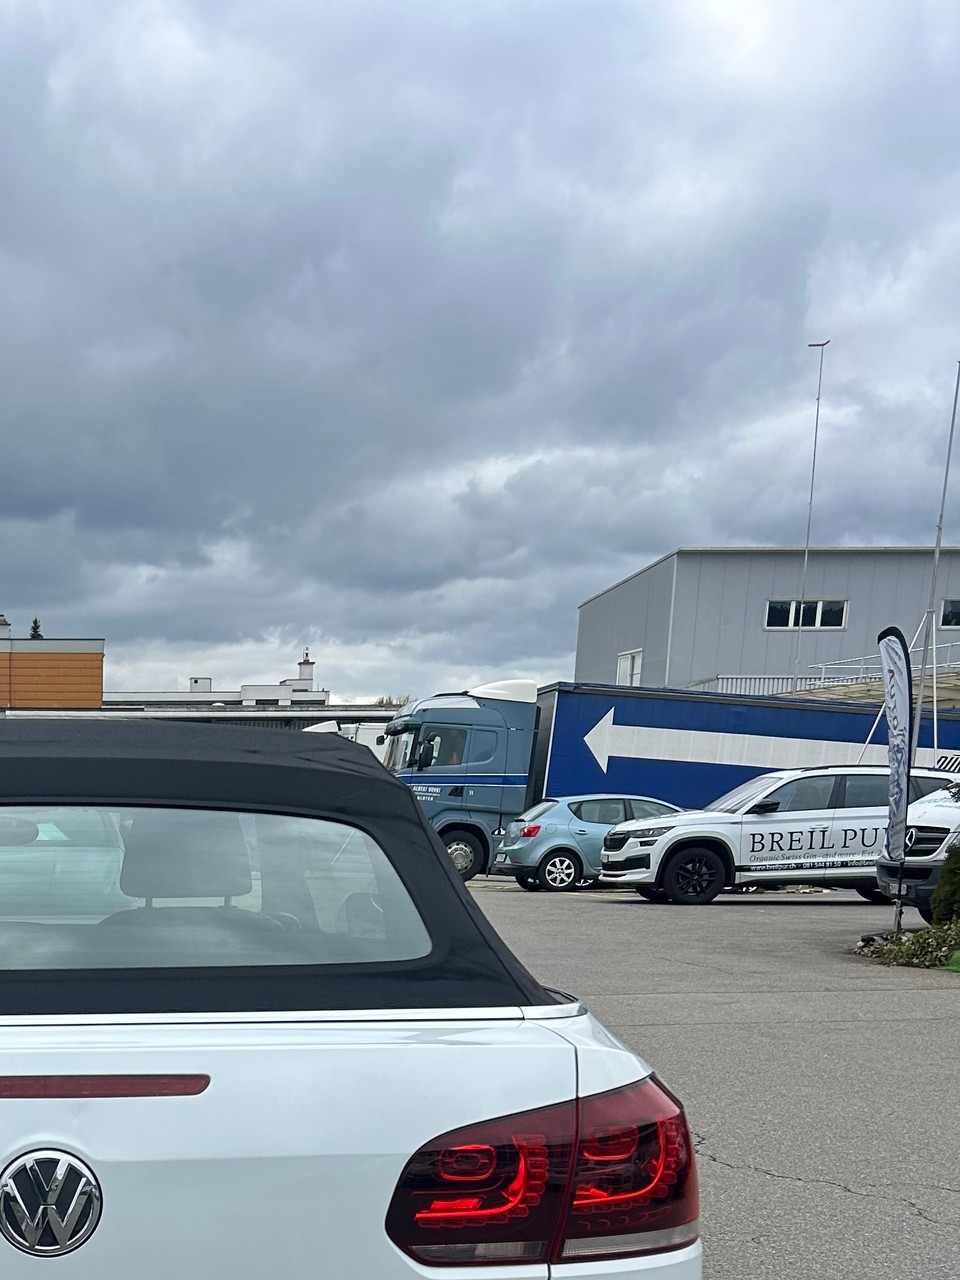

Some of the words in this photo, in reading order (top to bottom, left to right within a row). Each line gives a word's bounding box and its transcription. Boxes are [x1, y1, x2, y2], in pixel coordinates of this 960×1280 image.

[749, 829, 835, 852] BREIL
[749, 854, 780, 863] Organic
[781, 853, 801, 861] Swiss
